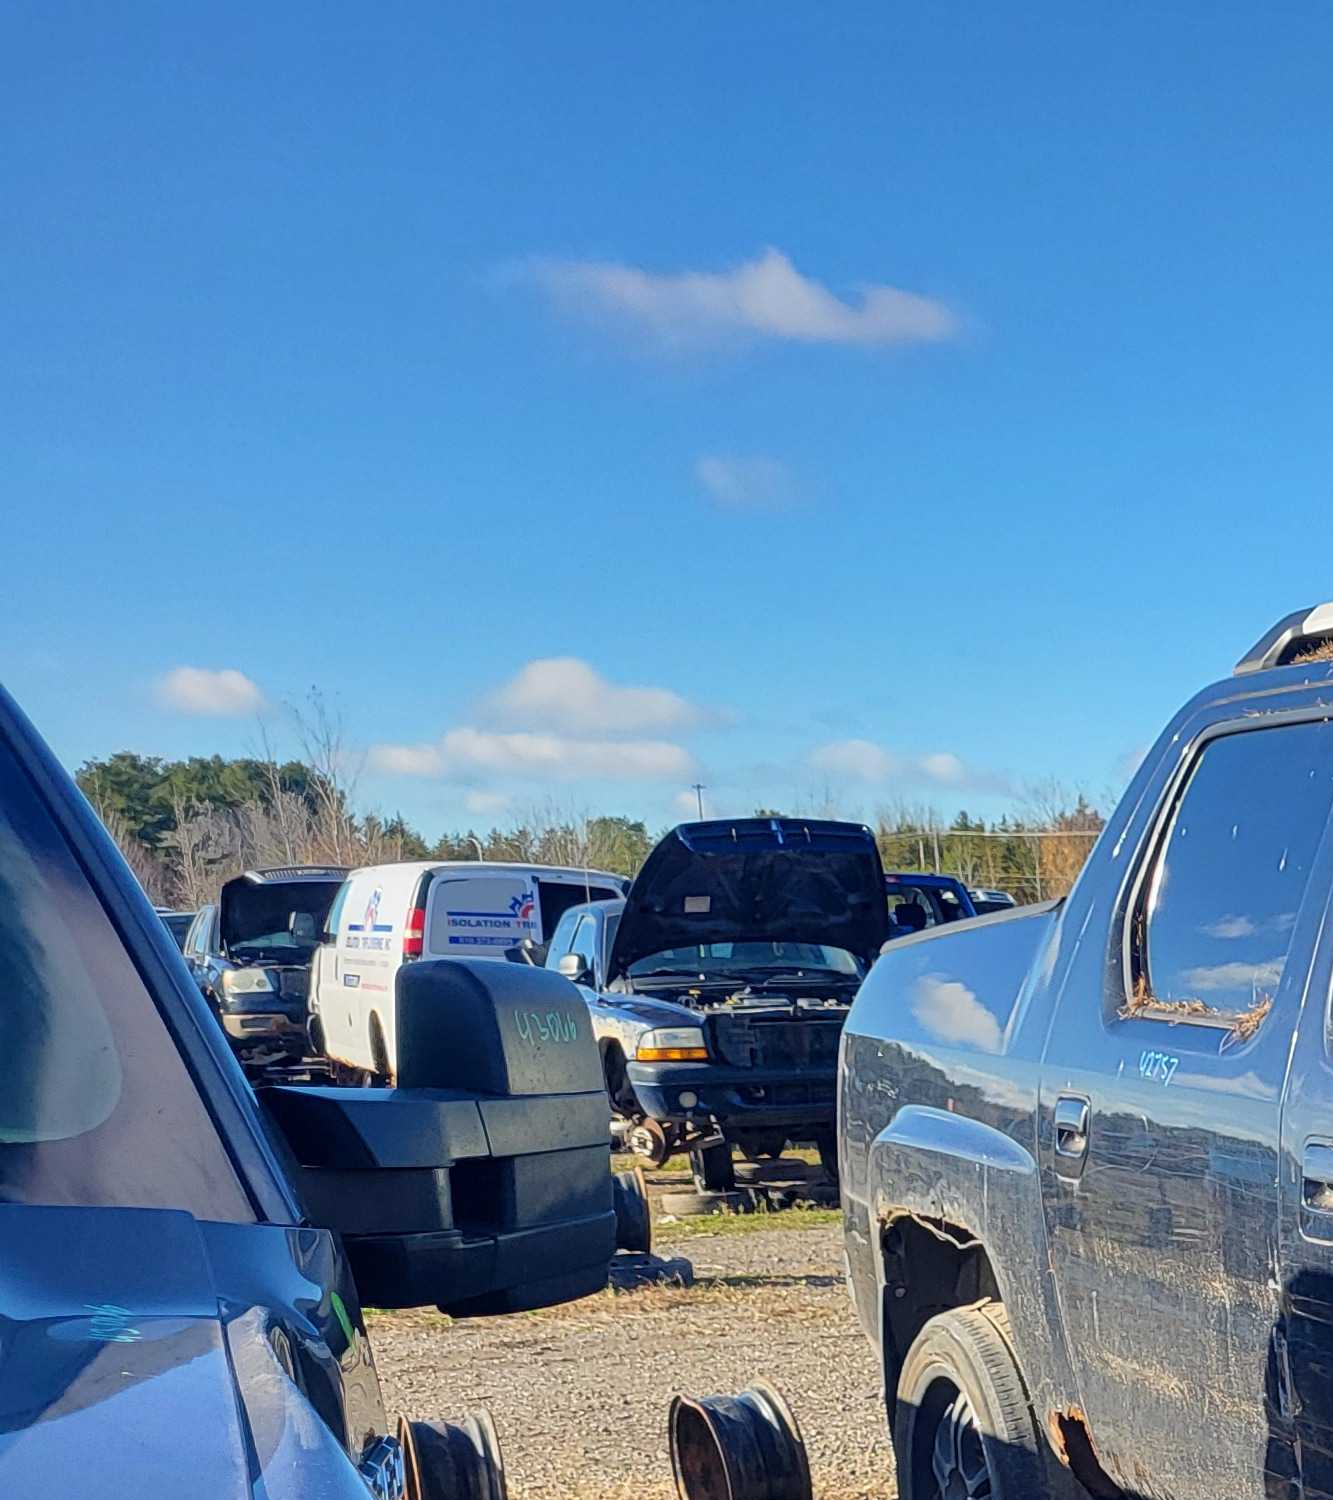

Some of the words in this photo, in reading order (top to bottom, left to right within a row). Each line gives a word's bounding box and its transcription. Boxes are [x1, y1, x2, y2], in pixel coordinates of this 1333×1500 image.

[447, 919, 511, 929] ISOLATION
[513, 1010, 577, 1047] 43066
[1139, 1050, 1179, 1088] 42757
